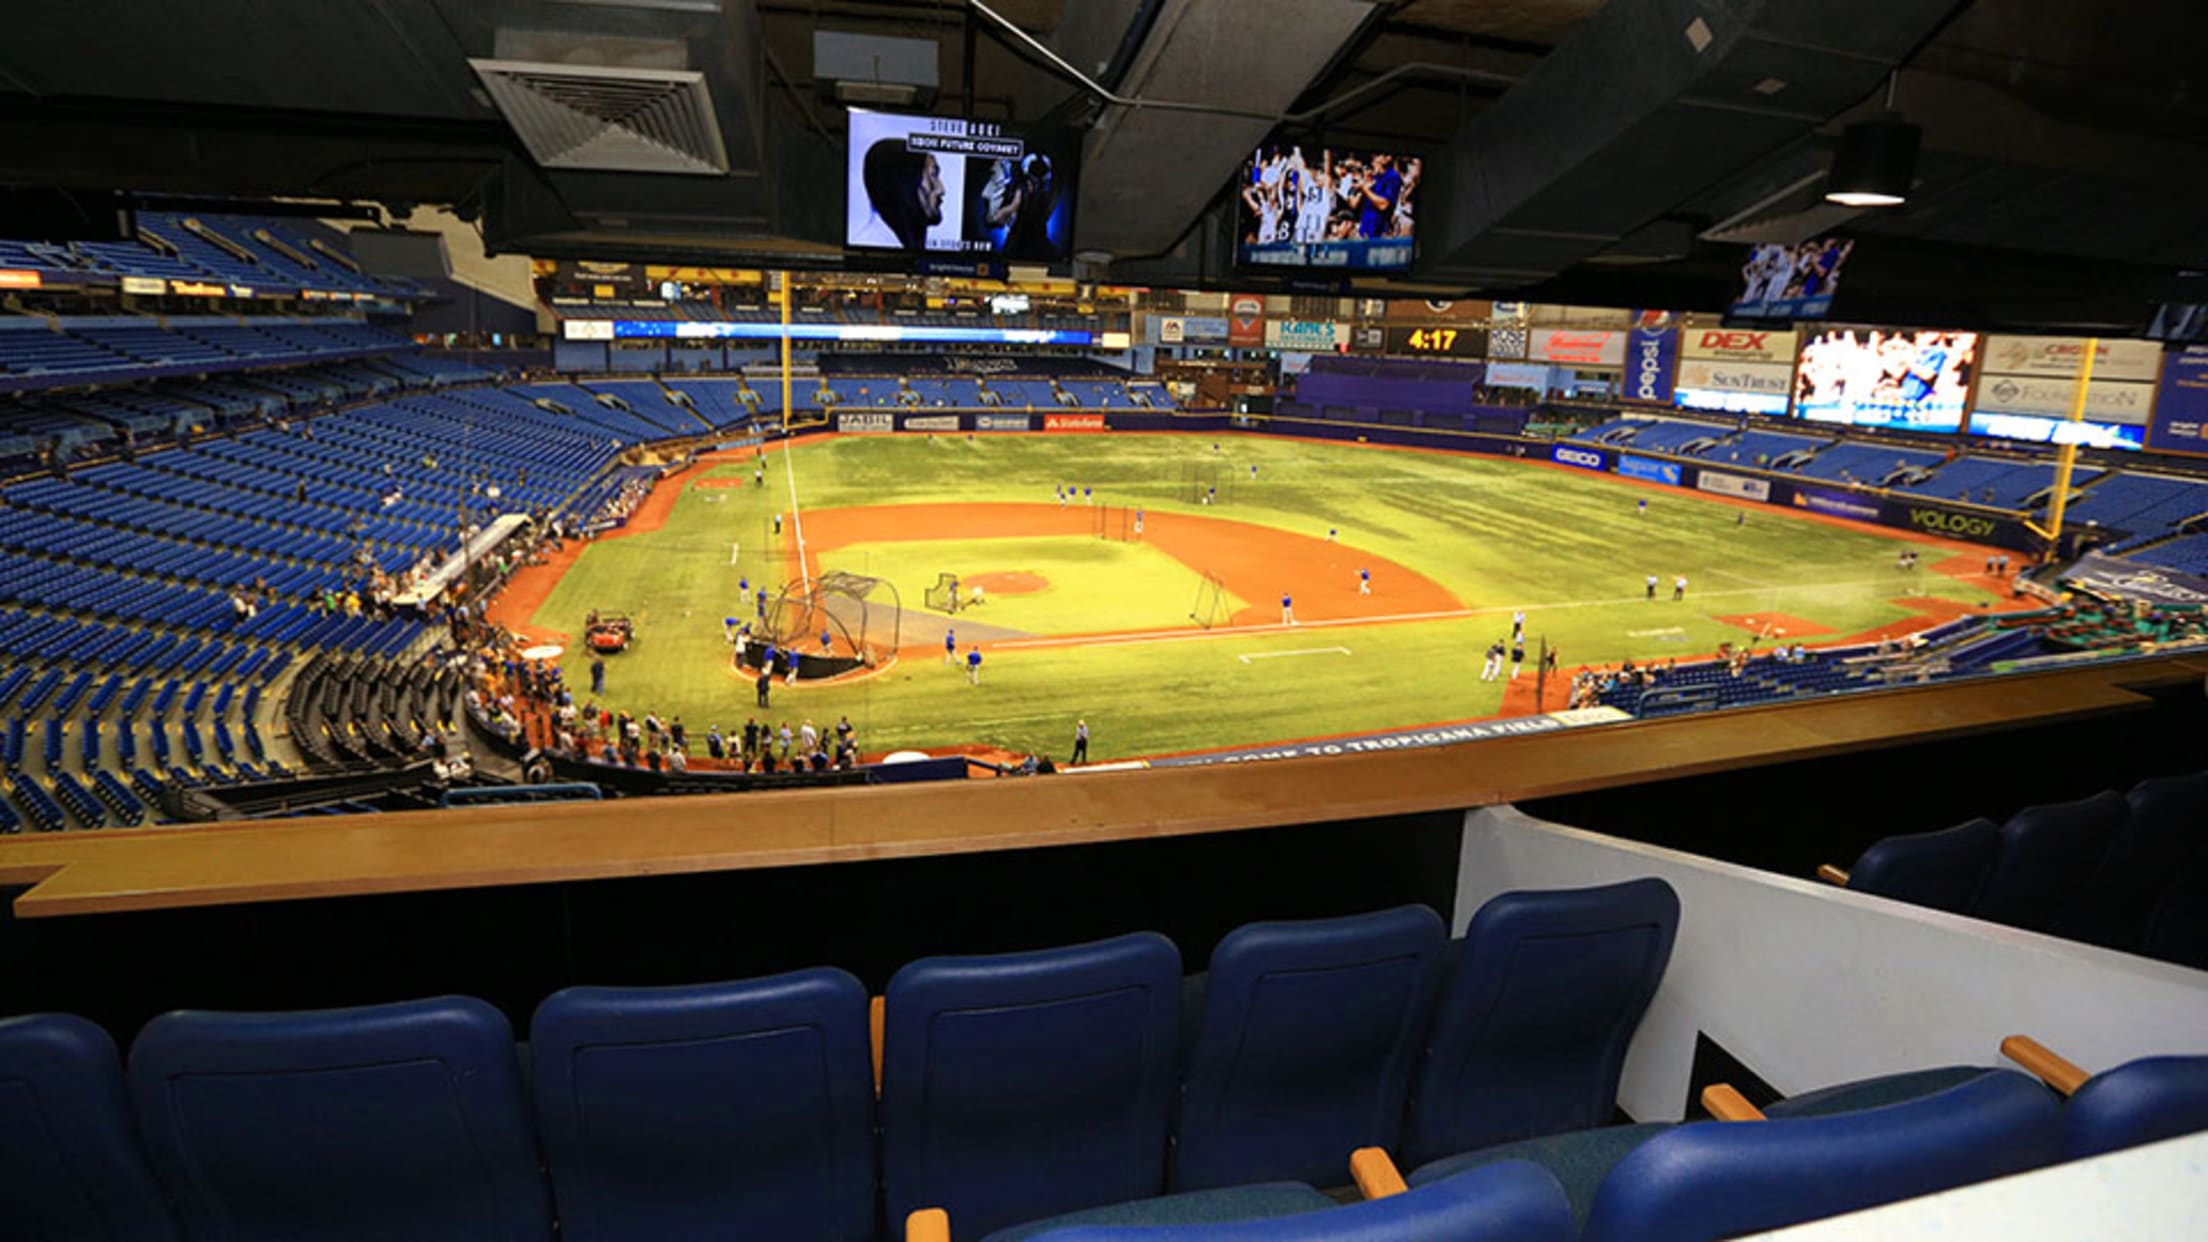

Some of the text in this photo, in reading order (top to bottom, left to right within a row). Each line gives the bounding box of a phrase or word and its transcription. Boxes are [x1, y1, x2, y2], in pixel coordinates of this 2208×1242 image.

[1409, 329, 1457, 350] 4:17
[1699, 330, 1769, 350] DEX
[1638, 339, 1662, 400] pepsi
[1556, 448, 1600, 467] GEICO
[1910, 509, 1995, 537] VOLOGY
[1305, 745, 1342, 757] TO
[1346, 727, 1491, 752] TROPICANA
[1491, 719, 1560, 735] FIELD
